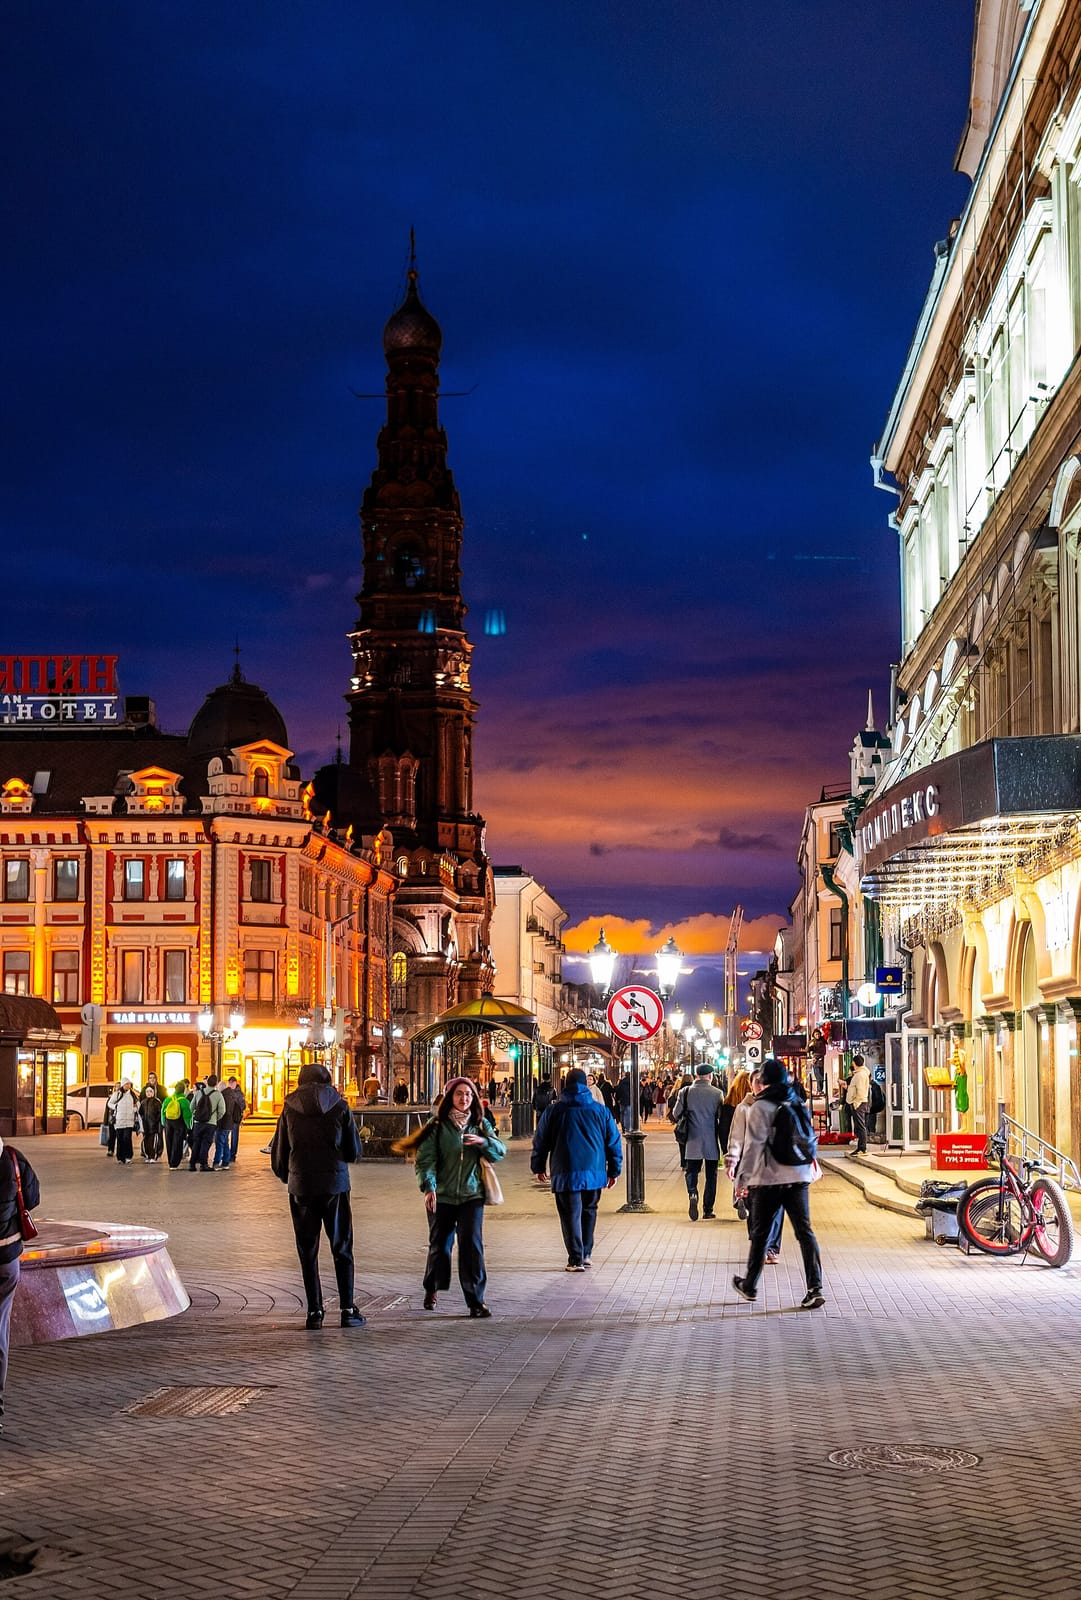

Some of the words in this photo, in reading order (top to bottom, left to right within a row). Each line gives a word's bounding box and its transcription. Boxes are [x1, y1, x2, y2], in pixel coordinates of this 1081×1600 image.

[16, 703, 117, 720] HOTEL
[113, 1011, 136, 1023] ЧАЙ
[876, 1071, 886, 1080] 24
